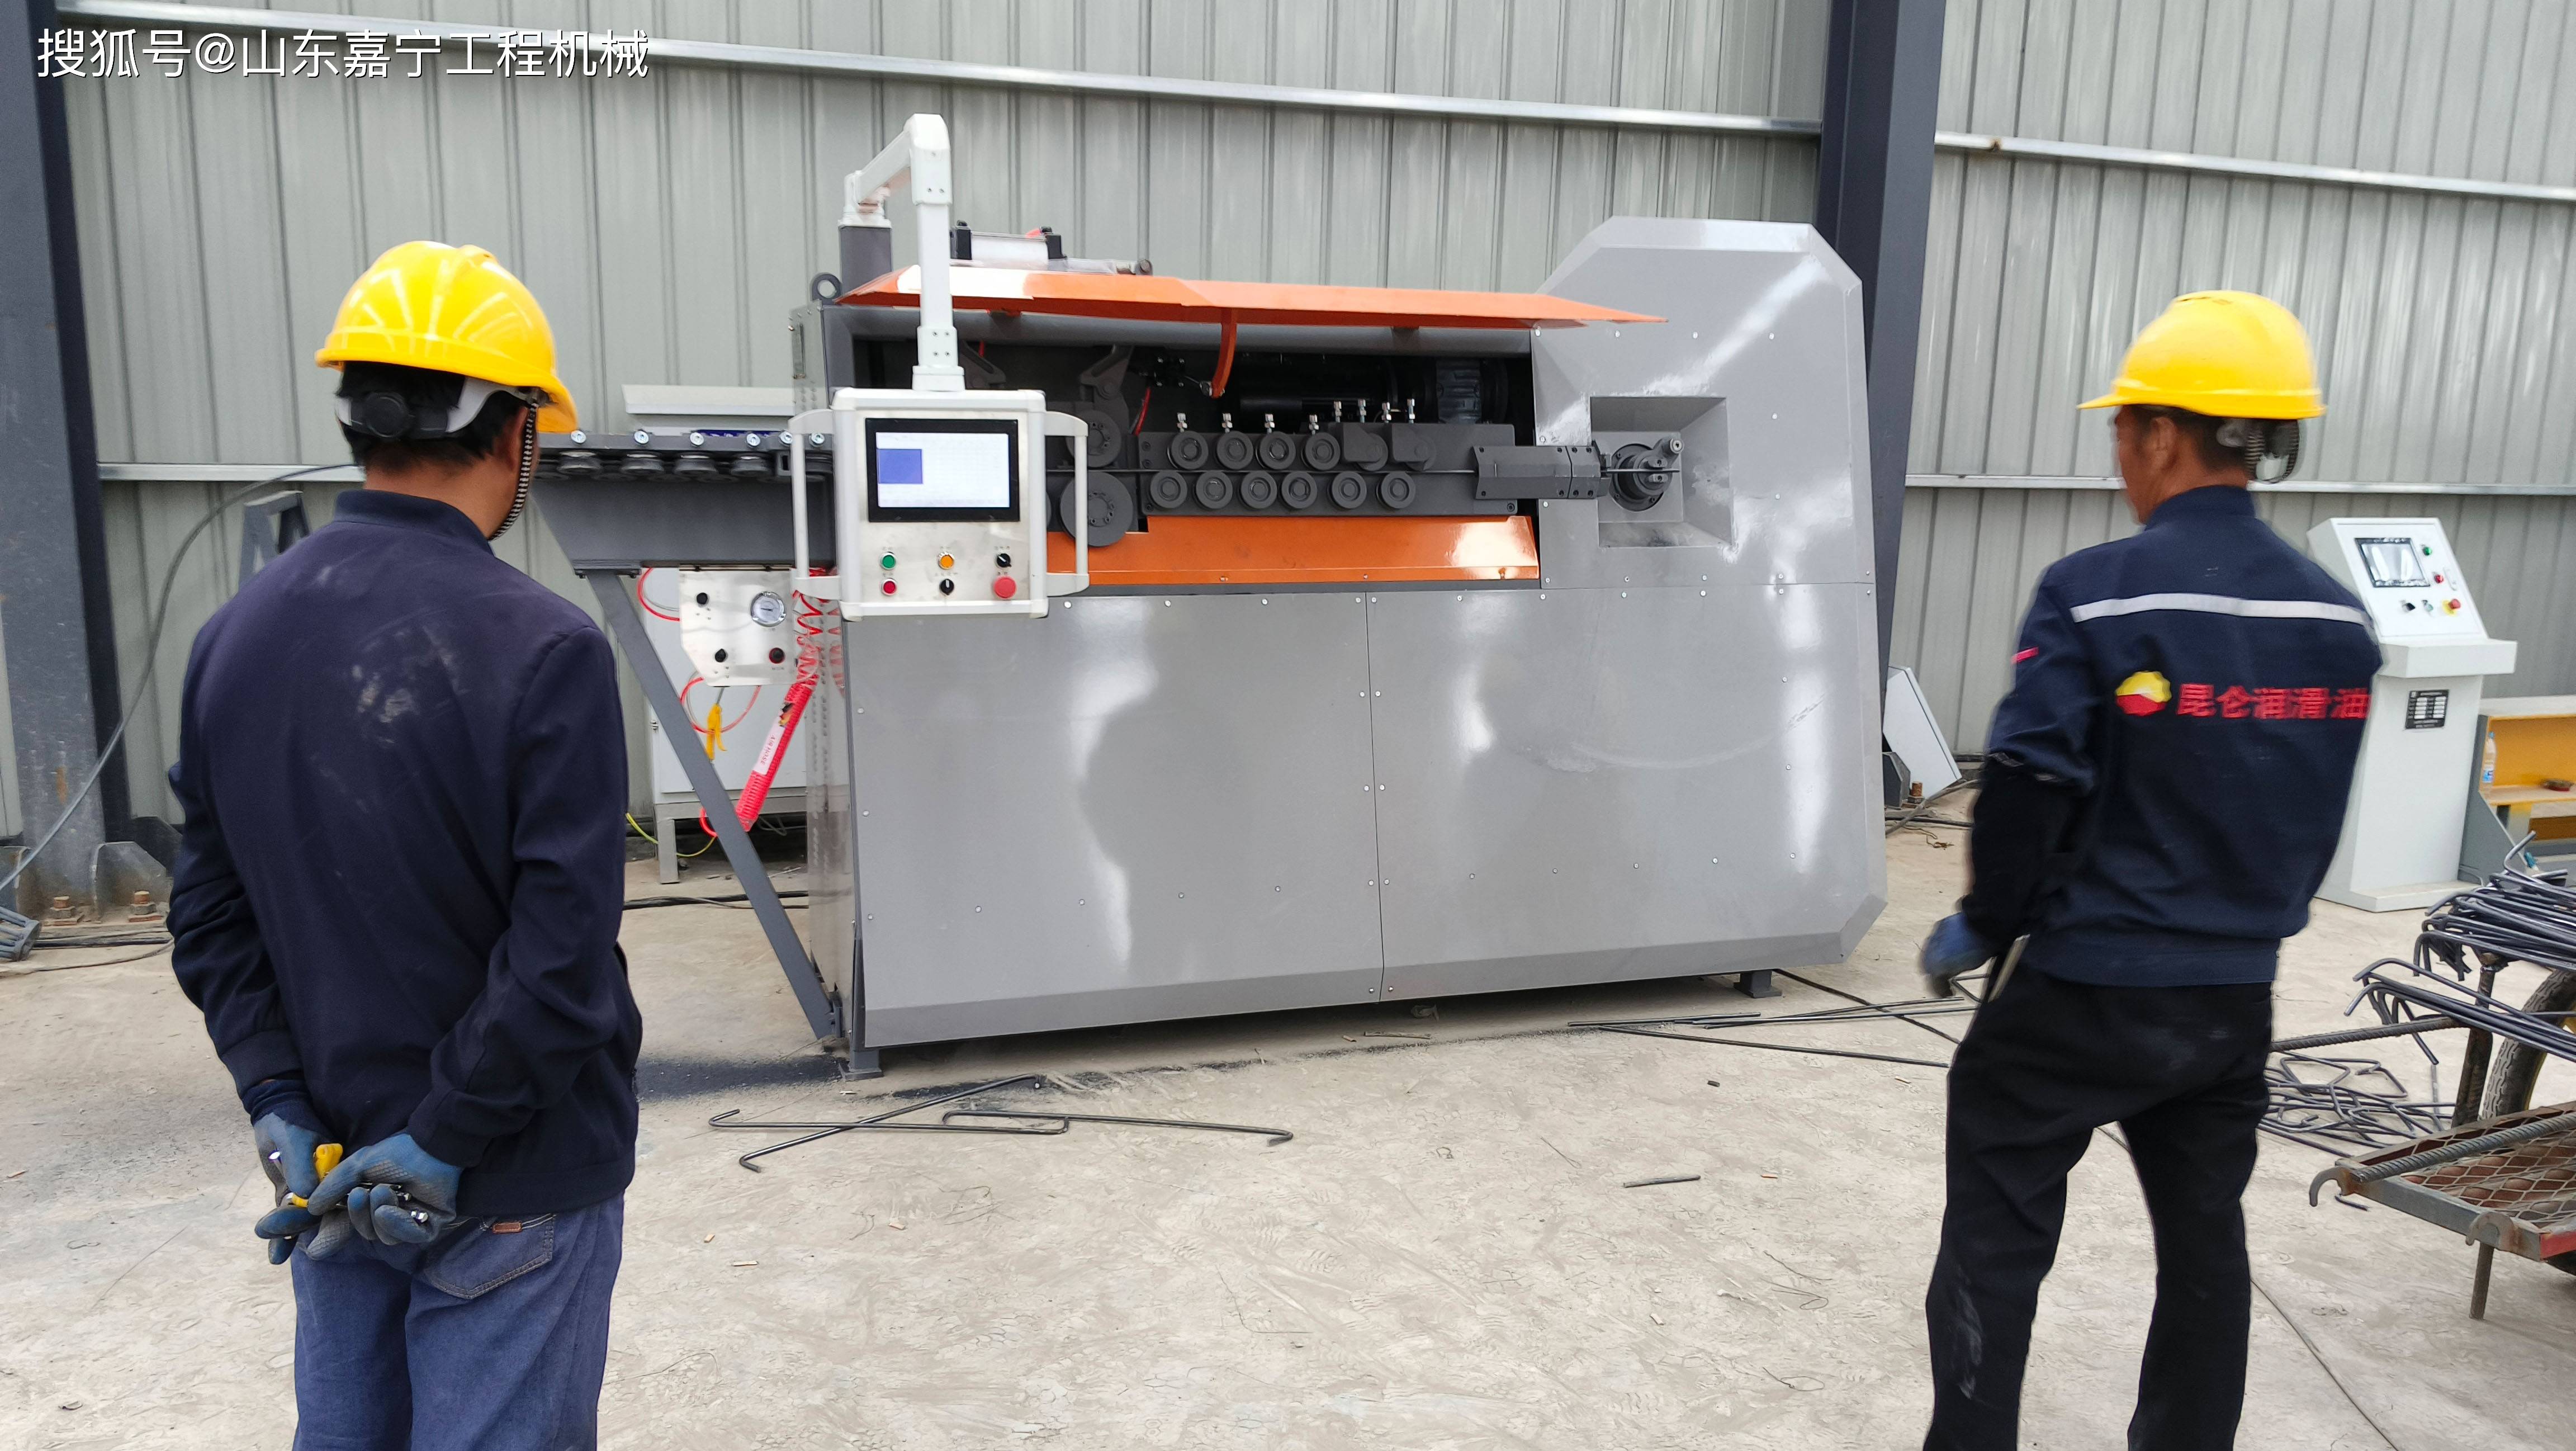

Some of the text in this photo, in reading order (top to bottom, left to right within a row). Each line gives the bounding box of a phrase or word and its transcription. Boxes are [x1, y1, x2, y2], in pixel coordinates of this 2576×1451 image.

[2176, 683, 2370, 719] 昆仑润滑油
